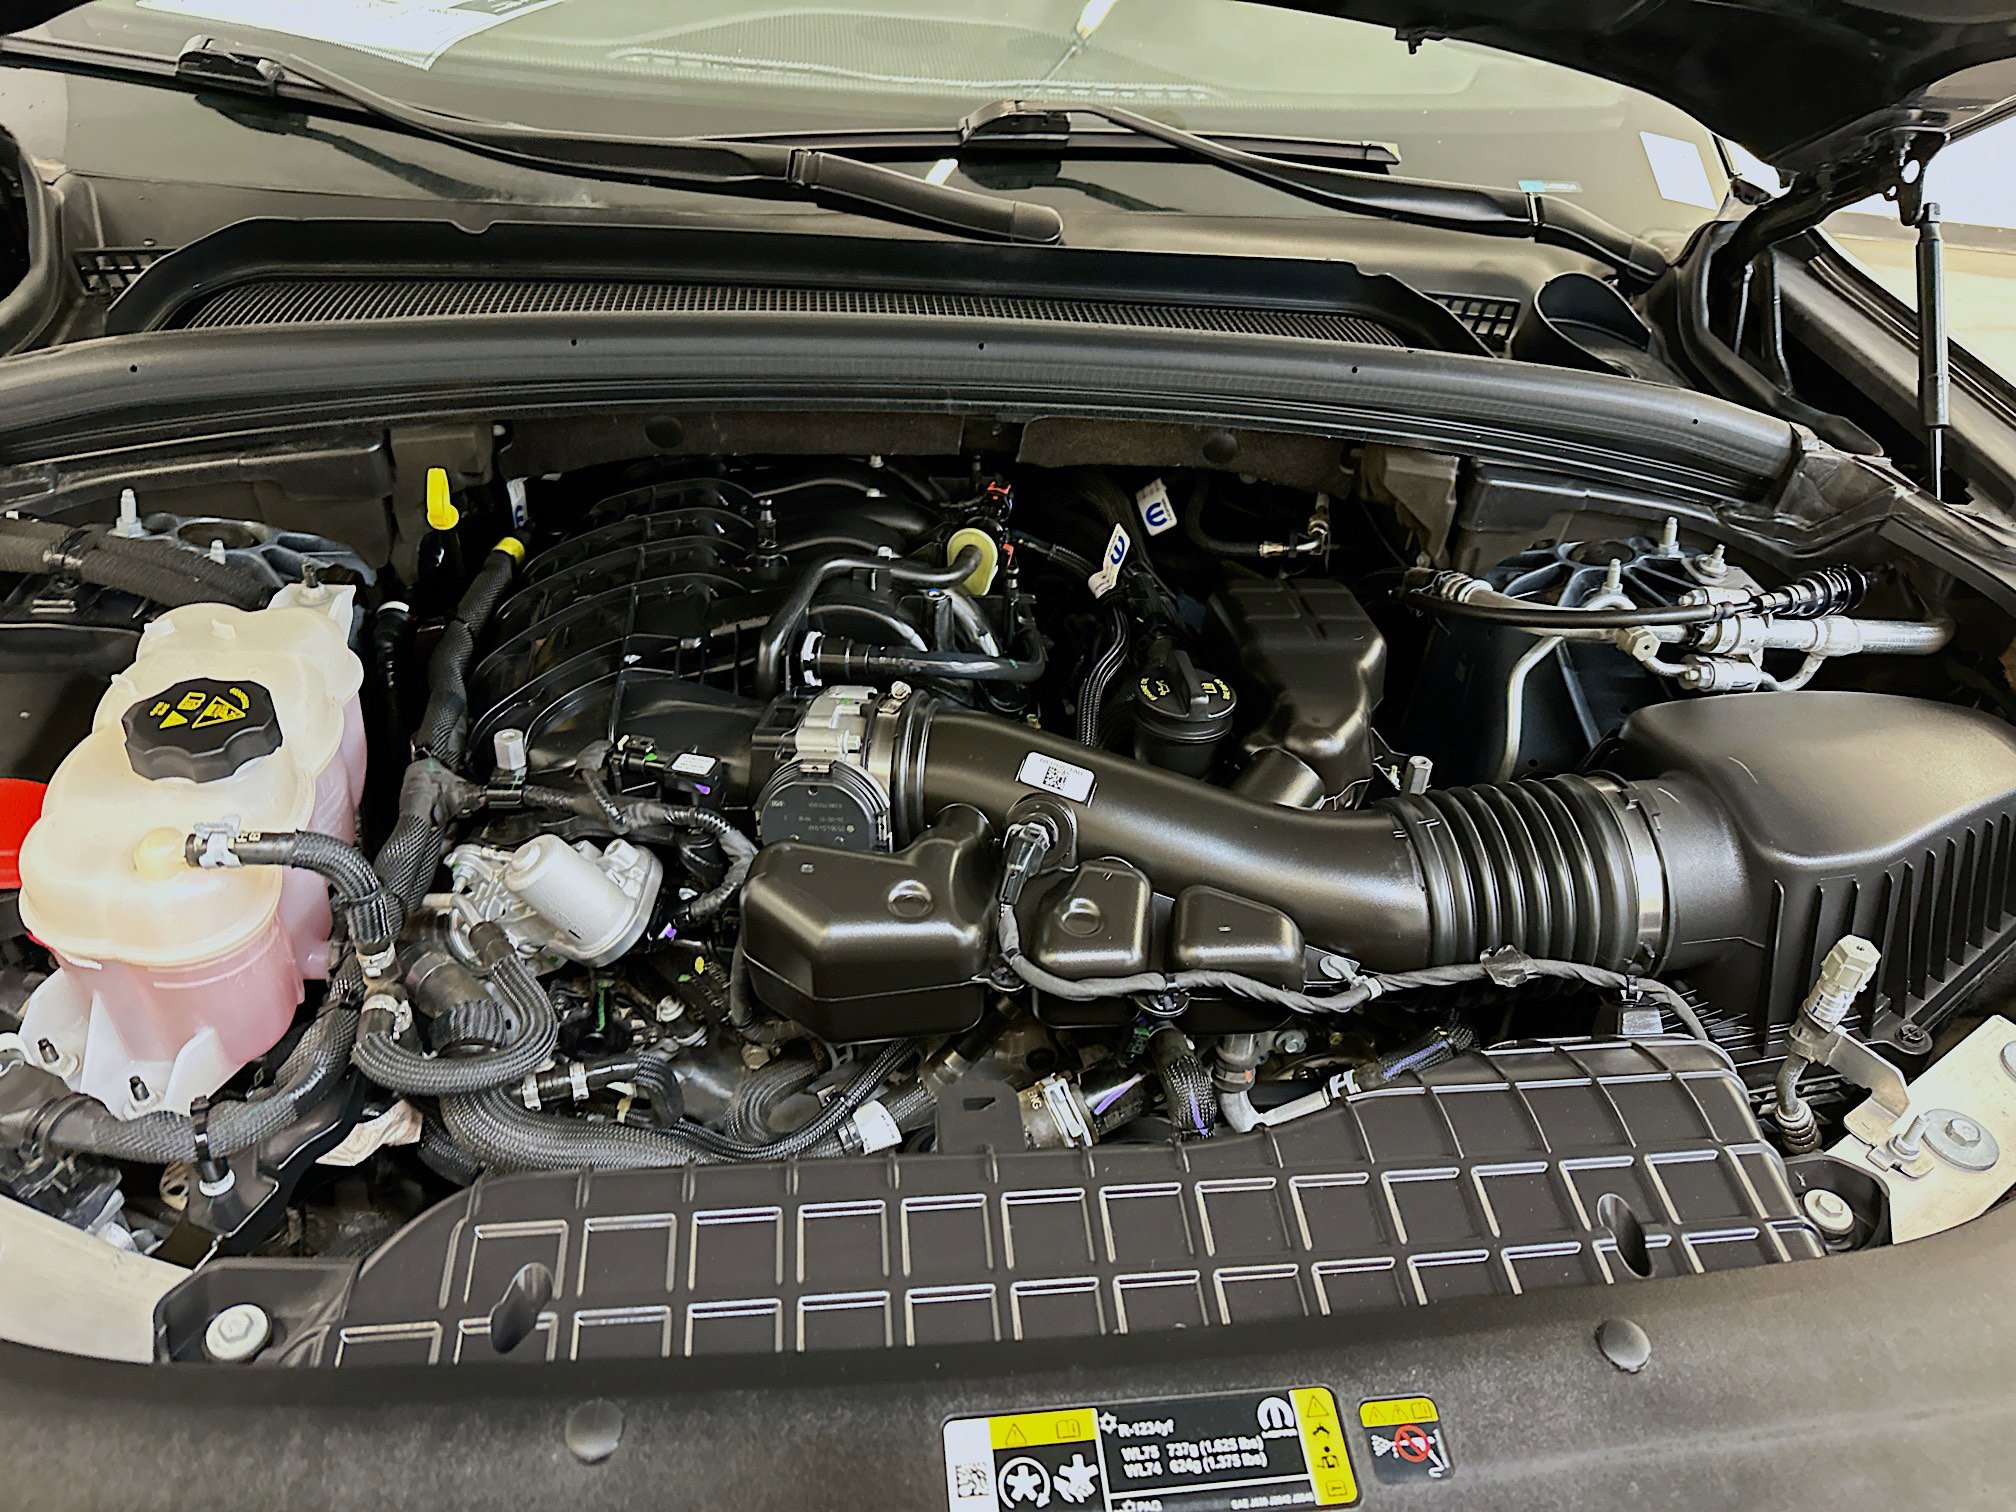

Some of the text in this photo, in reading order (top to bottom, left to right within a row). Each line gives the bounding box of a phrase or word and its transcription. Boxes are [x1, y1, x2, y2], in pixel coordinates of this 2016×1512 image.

[1027, 1090, 1043, 1110] ENG
[1118, 1419, 1174, 1438] R-1234yf
[1121, 1445, 1160, 1462] WL75
[1123, 1461, 1163, 1479] WL74
